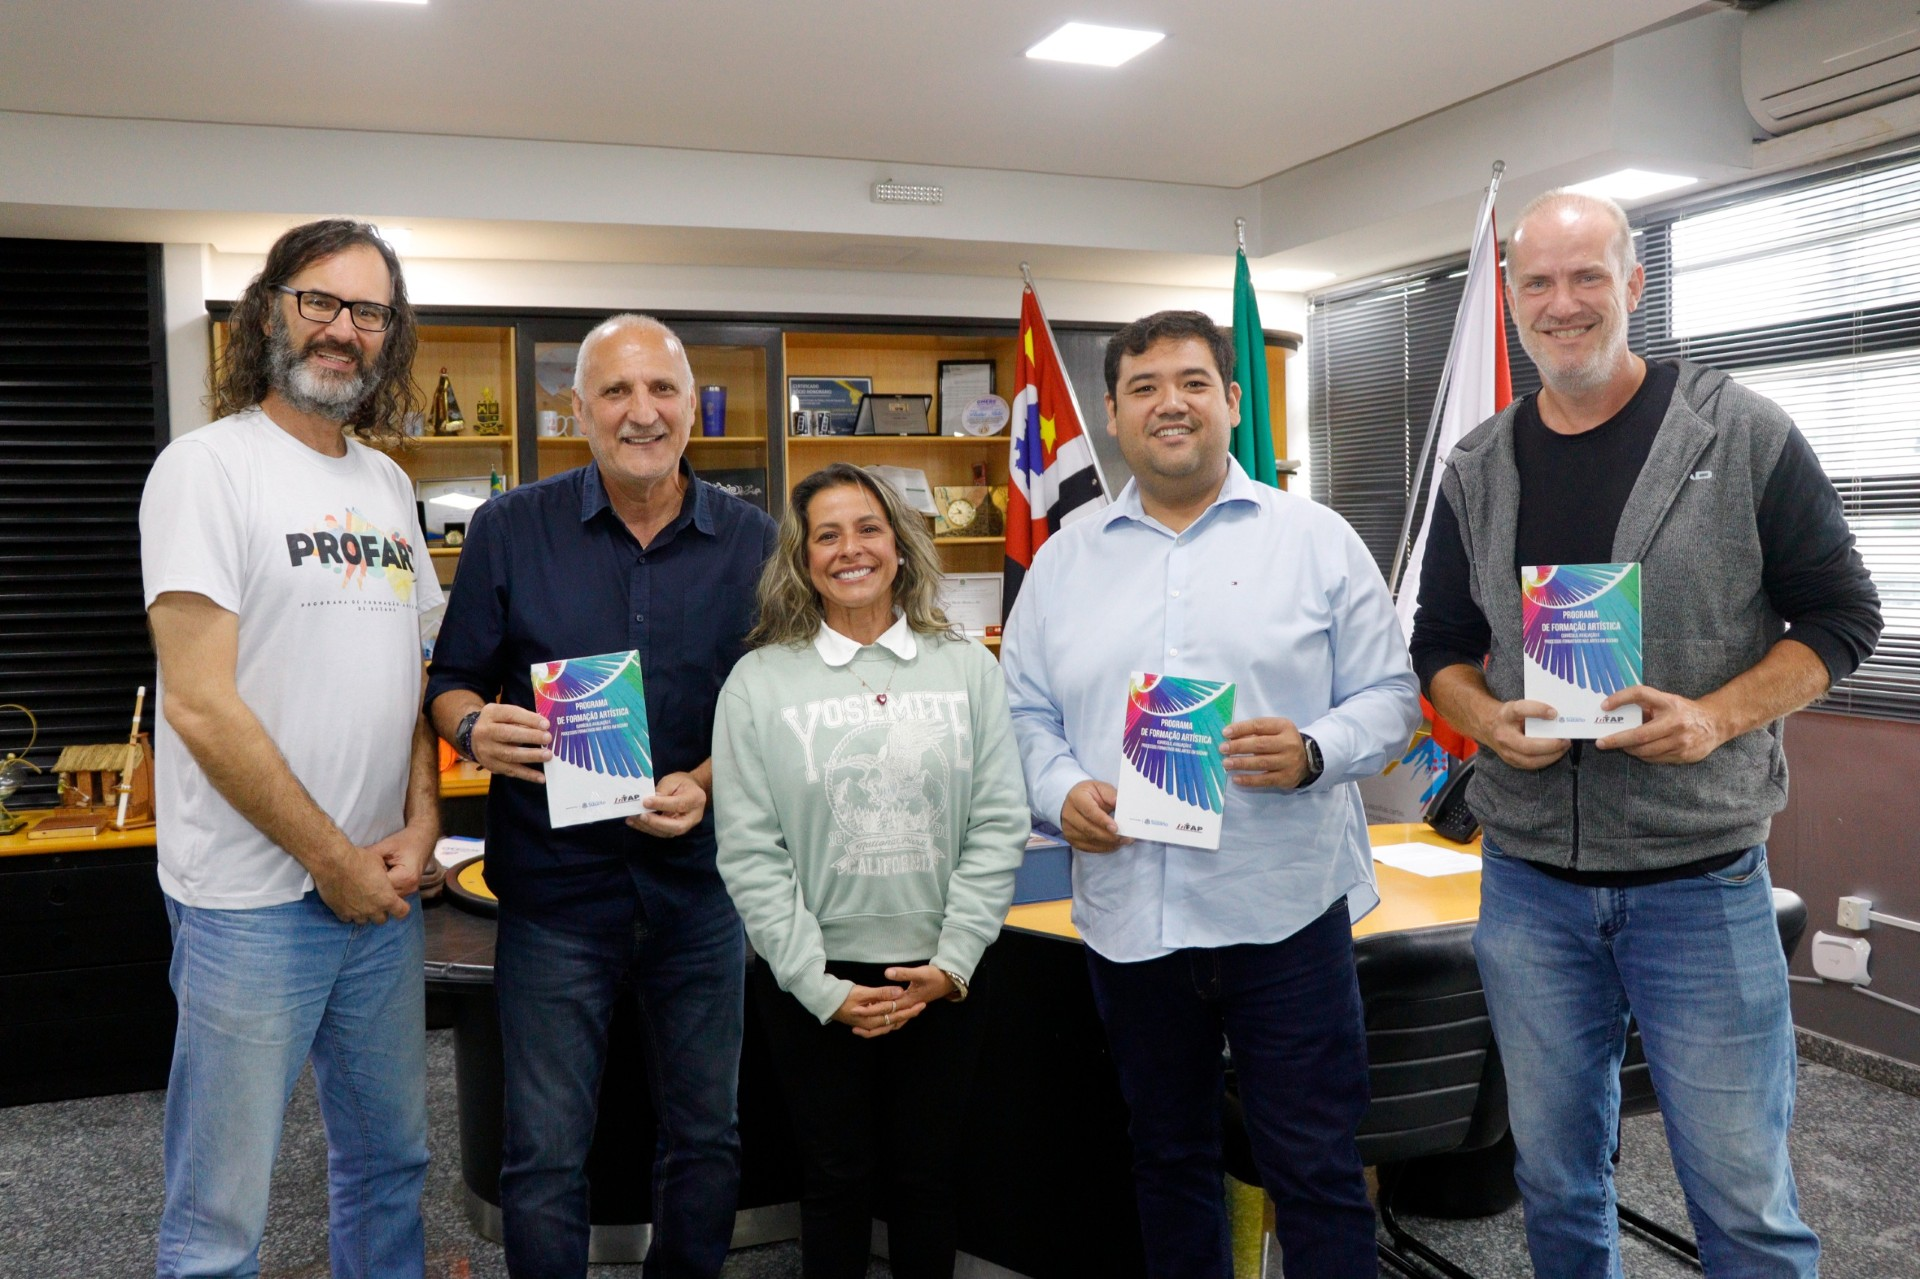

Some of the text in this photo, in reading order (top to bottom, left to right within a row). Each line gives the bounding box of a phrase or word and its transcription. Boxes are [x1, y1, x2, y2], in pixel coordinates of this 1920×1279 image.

[1563, 610, 1598, 619] PROGRAMA
[1541, 620, 1621, 632] DE FORMAÇÃO ARTÍSTICA
[575, 699, 608, 711] PROGRAMA
[556, 707, 629, 725] DE FORMAÇÃO ARTÍSTICA
[1160, 719, 1193, 730] PROGRAMA
[780, 690, 973, 785] YOSEMITE
[1140, 727, 1212, 744] DE FORMAÇÃO ARTÍSTICA
[855, 838, 900, 851] National
[847, 854, 934, 876] CALIFORNIA
